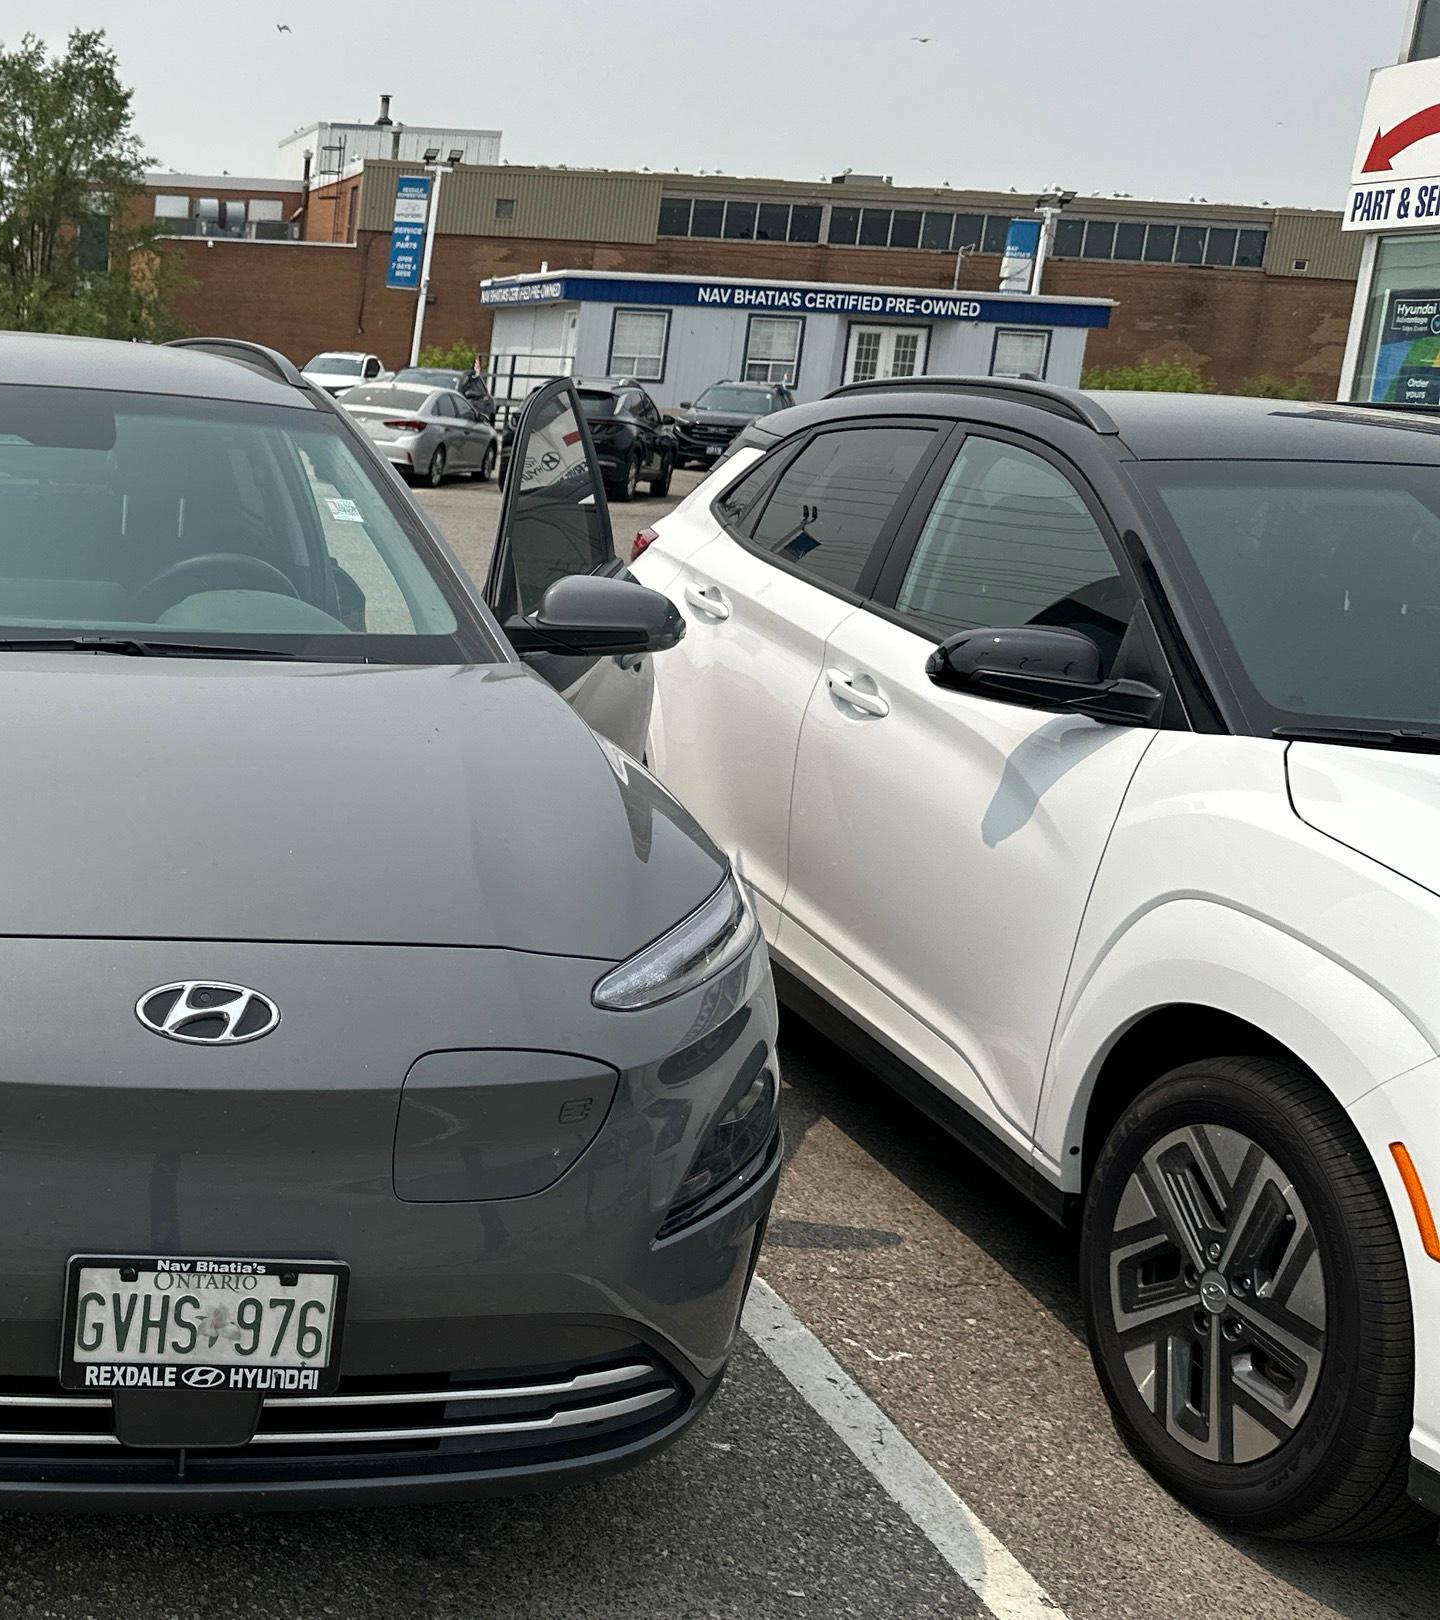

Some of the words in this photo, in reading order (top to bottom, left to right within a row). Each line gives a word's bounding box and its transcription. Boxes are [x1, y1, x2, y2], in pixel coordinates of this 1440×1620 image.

[1350, 189, 1395, 222] PART
[1397, 187, 1410, 219] &
[697, 288, 732, 303] NAV
[734, 289, 801, 308] BHATIA'S
[805, 293, 882, 311] CERTIFIED
[886, 297, 980, 317] PRE-OWNED
[1397, 303, 1437, 316] Hyundai
[1407, 378, 1429, 388] Order
[157, 1260, 190, 1272] Nav
[196, 1260, 266, 1274] Bhatia's
[154, 1272, 257, 1293] ONTARIO
[77, 1292, 200, 1354] GVHS
[234, 1297, 326, 1358] 976
[85, 1366, 176, 1387] REXDALE
[229, 1368, 319, 1390] HYUNDAI
